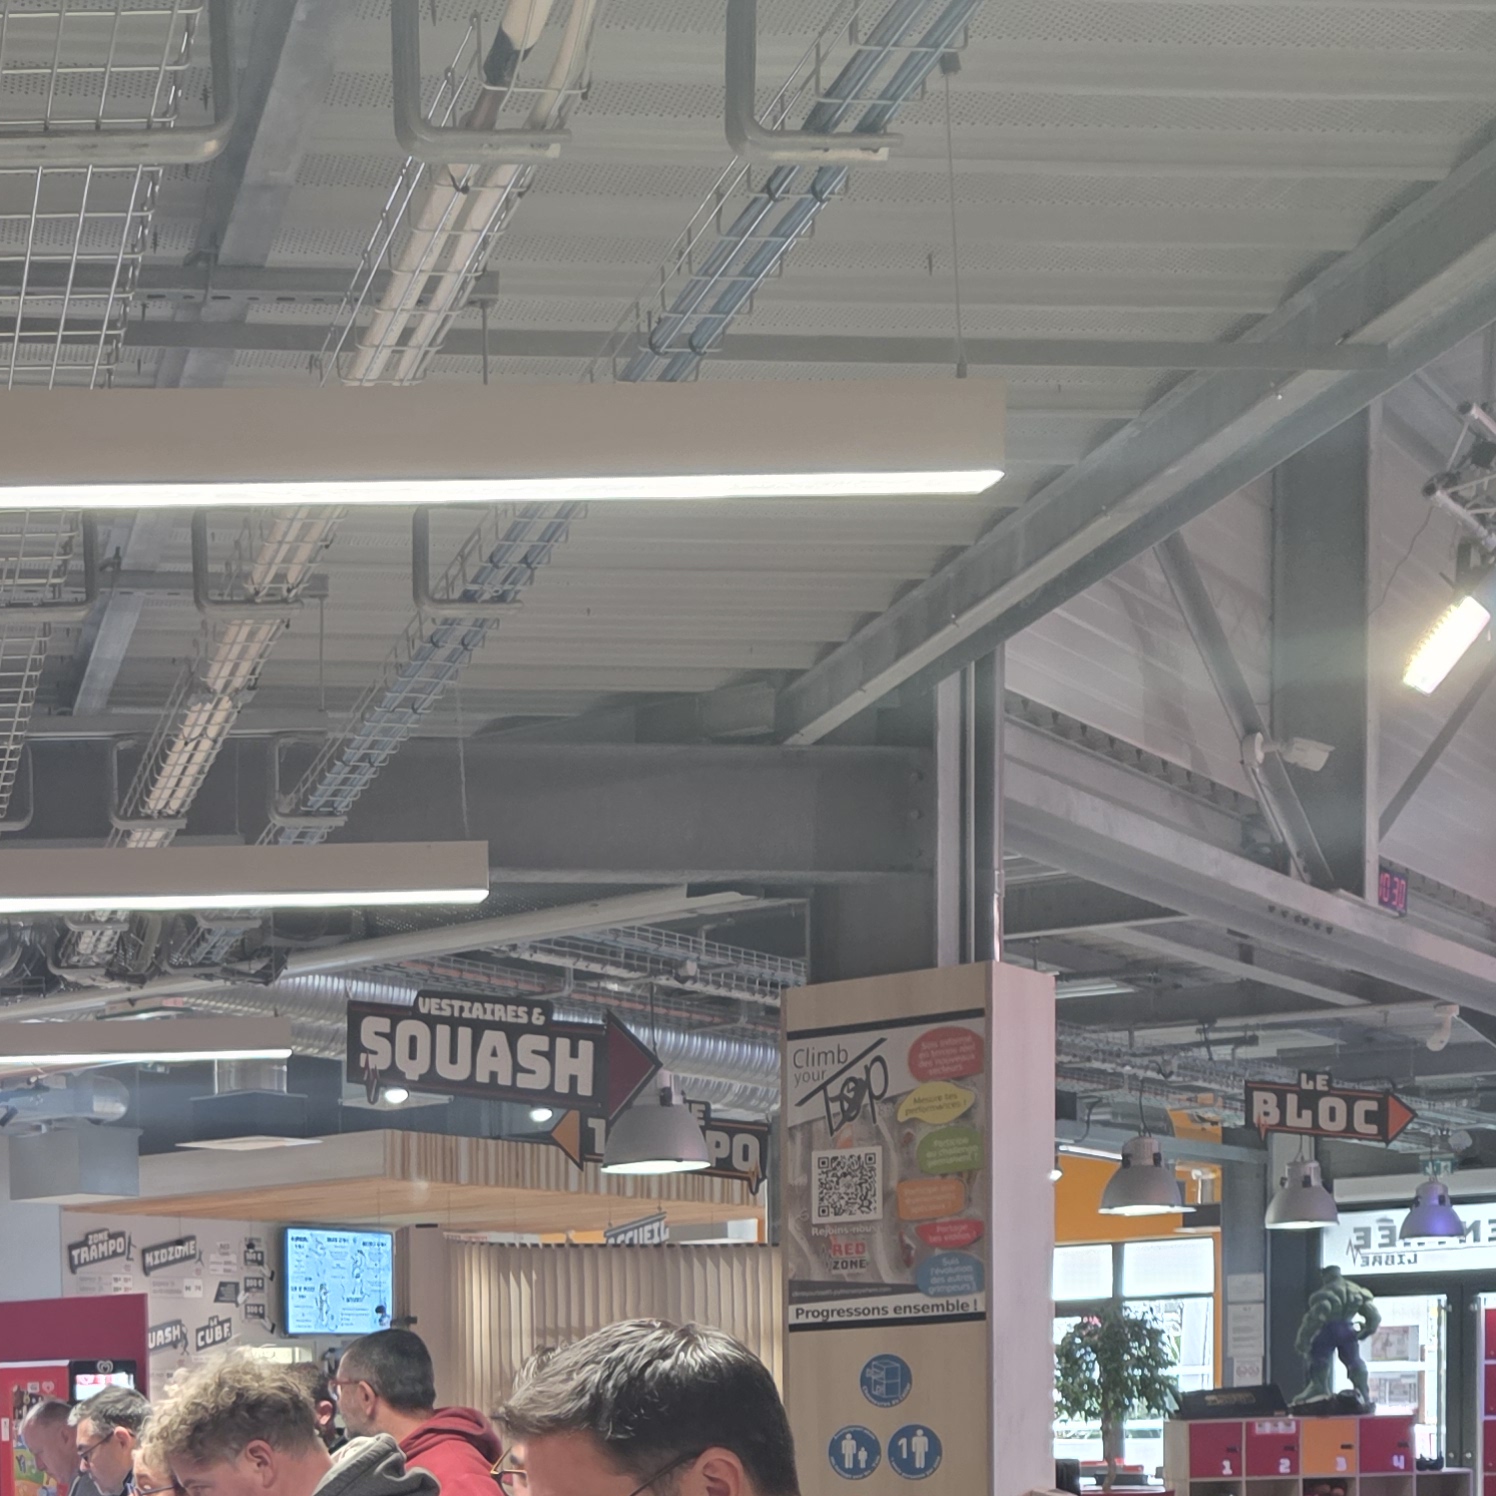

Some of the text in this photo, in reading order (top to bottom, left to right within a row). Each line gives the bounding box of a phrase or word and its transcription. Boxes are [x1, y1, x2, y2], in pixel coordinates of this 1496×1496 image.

[418, 996, 545, 1026] VESTIAIRES &
[360, 1015, 594, 1097] SQUASH
[793, 1044, 849, 1069] Climb
[794, 1069, 827, 1088] your
[1300, 1073, 1330, 1092] LE
[1252, 1090, 1380, 1135] BLOC
[88, 1230, 110, 1246] ZONE
[71, 1236, 125, 1266] TRAMPO
[144, 1240, 197, 1267] KIDZONE
[832, 1242, 866, 1257] RED
[832, 1259, 867, 1271] ZONE
[795, 1304, 889, 1322] Progressons
[893, 1300, 970, 1315] ensemble
[148, 1324, 181, 1350] UASH
[1222, 1459, 1233, 1475] 1
[1278, 1458, 1291, 1474] 2
[1335, 1456, 1348, 1472] 3
[1392, 1454, 1405, 1470] 4
